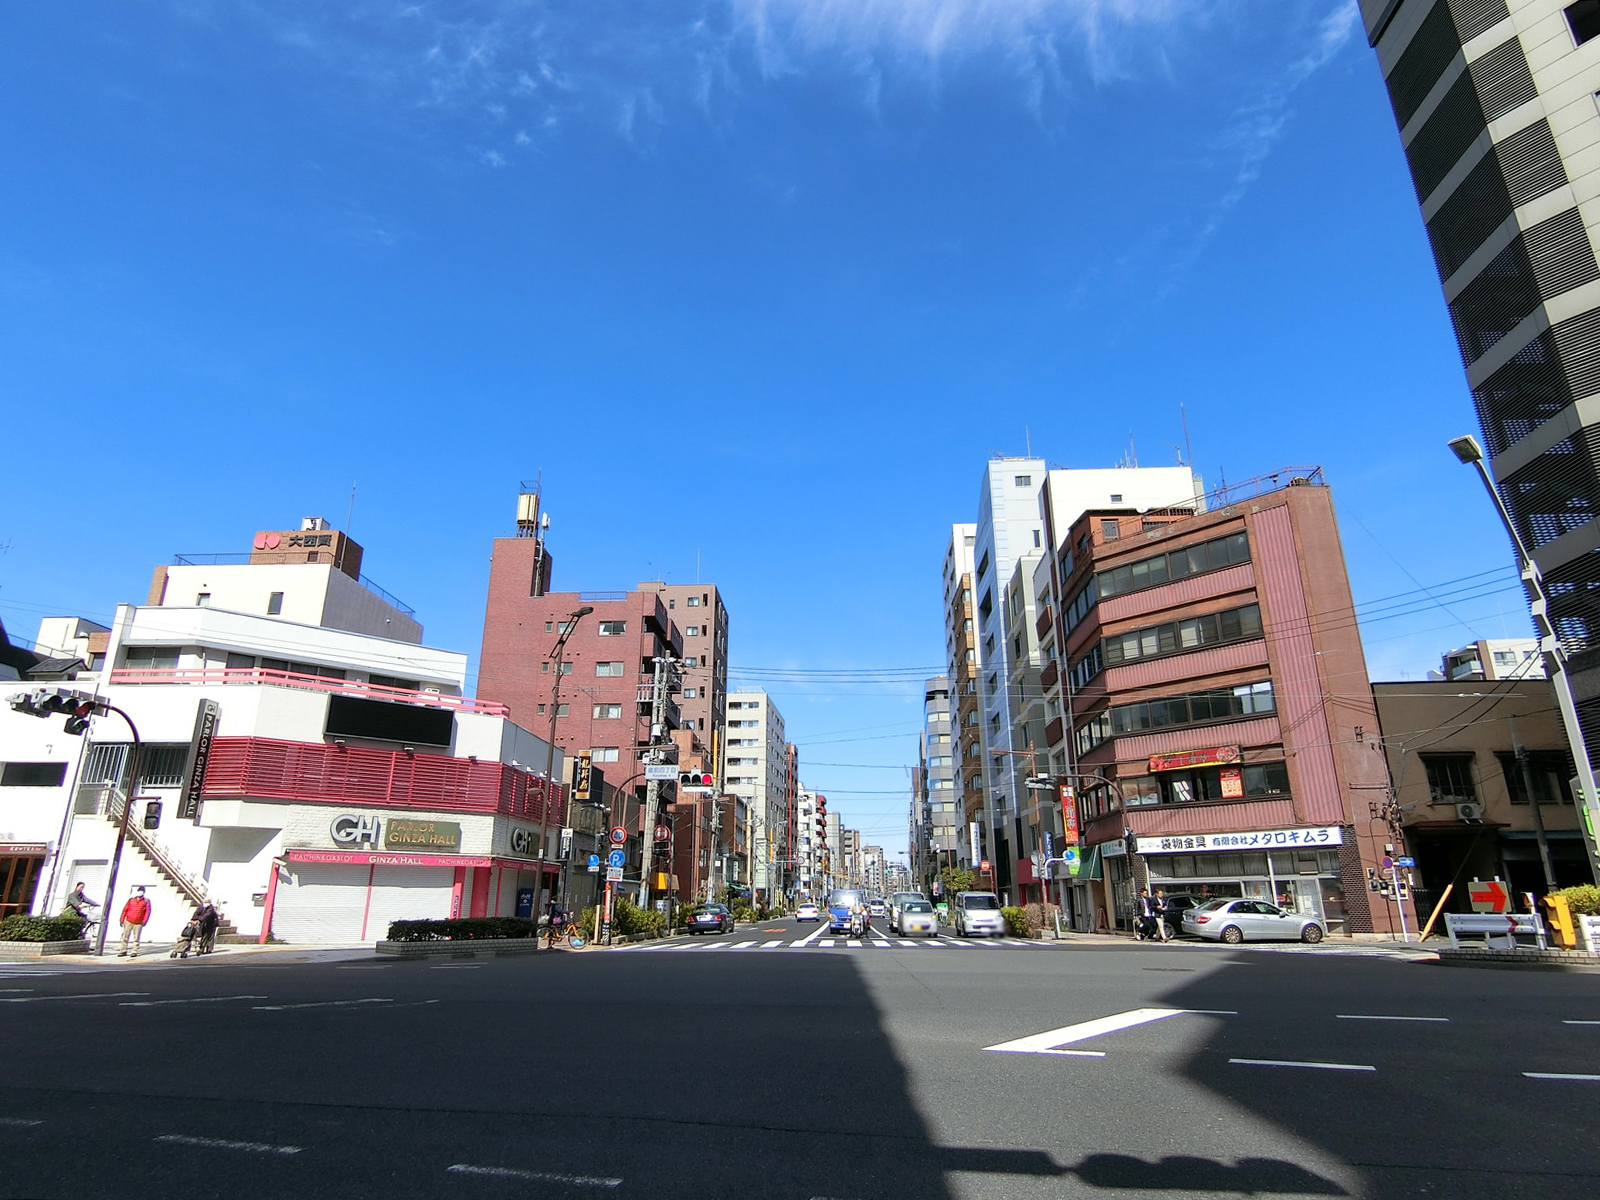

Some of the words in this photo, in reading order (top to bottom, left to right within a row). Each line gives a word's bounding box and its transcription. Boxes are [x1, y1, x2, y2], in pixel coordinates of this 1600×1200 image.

[199, 714, 215, 753] PARLOR
[192, 756, 205, 789] GINZA
[186, 791, 199, 816] HALL
[390, 821, 435, 832] PARLOR
[389, 832, 426, 843] GINZA
[429, 834, 456, 845] HALL
[368, 855, 399, 864] GINZA
[400, 857, 424, 865] HALL
